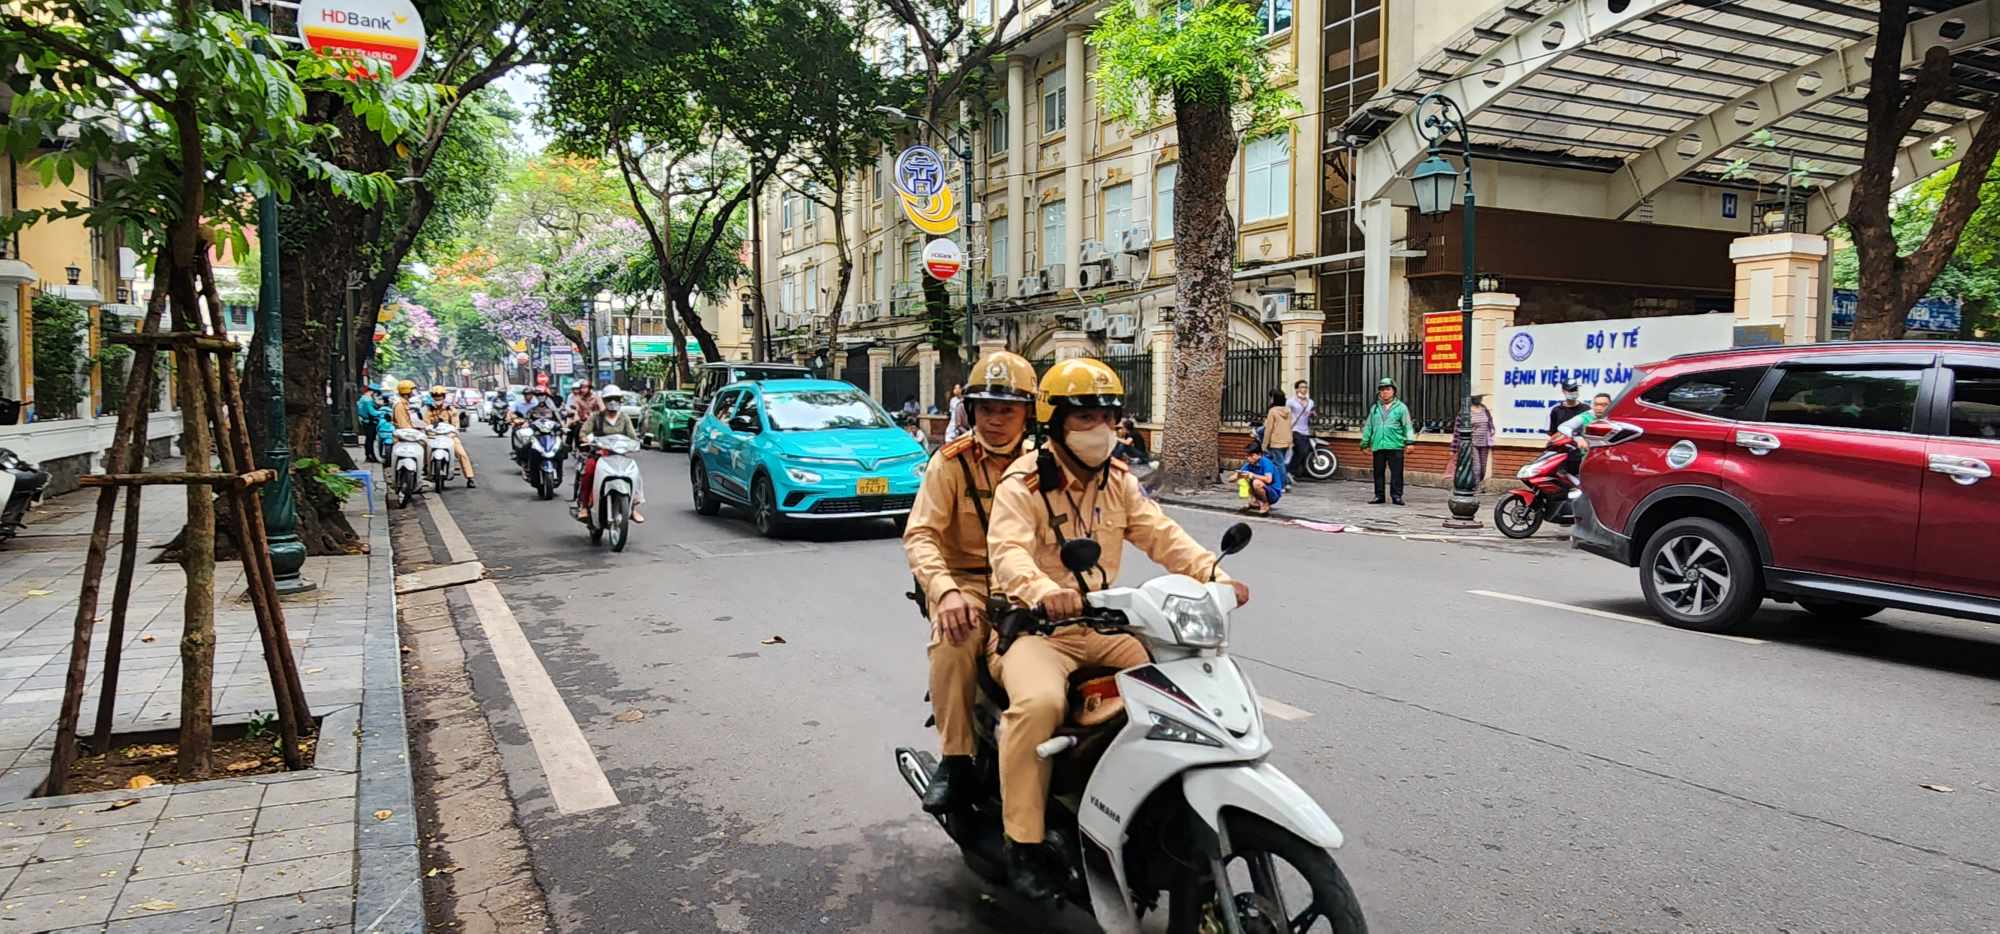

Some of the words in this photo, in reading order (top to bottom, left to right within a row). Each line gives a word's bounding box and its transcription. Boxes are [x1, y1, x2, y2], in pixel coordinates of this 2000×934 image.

[322, 9, 391, 30] HDBank
[1725, 196, 1735, 215] H
[1586, 330, 1604, 353] BỘ
[1609, 332, 1618, 349] Y
[1622, 326, 1641, 348] TẾ
[1504, 367, 1536, 388] BỆNH
[1540, 366, 1569, 388] VIỆN
[1573, 368, 1600, 388] PHỤ
[1604, 362, 1633, 385] SẢN
[1514, 399, 1546, 408] NATIONAL
[1090, 796, 1121, 824] YAMAHA
